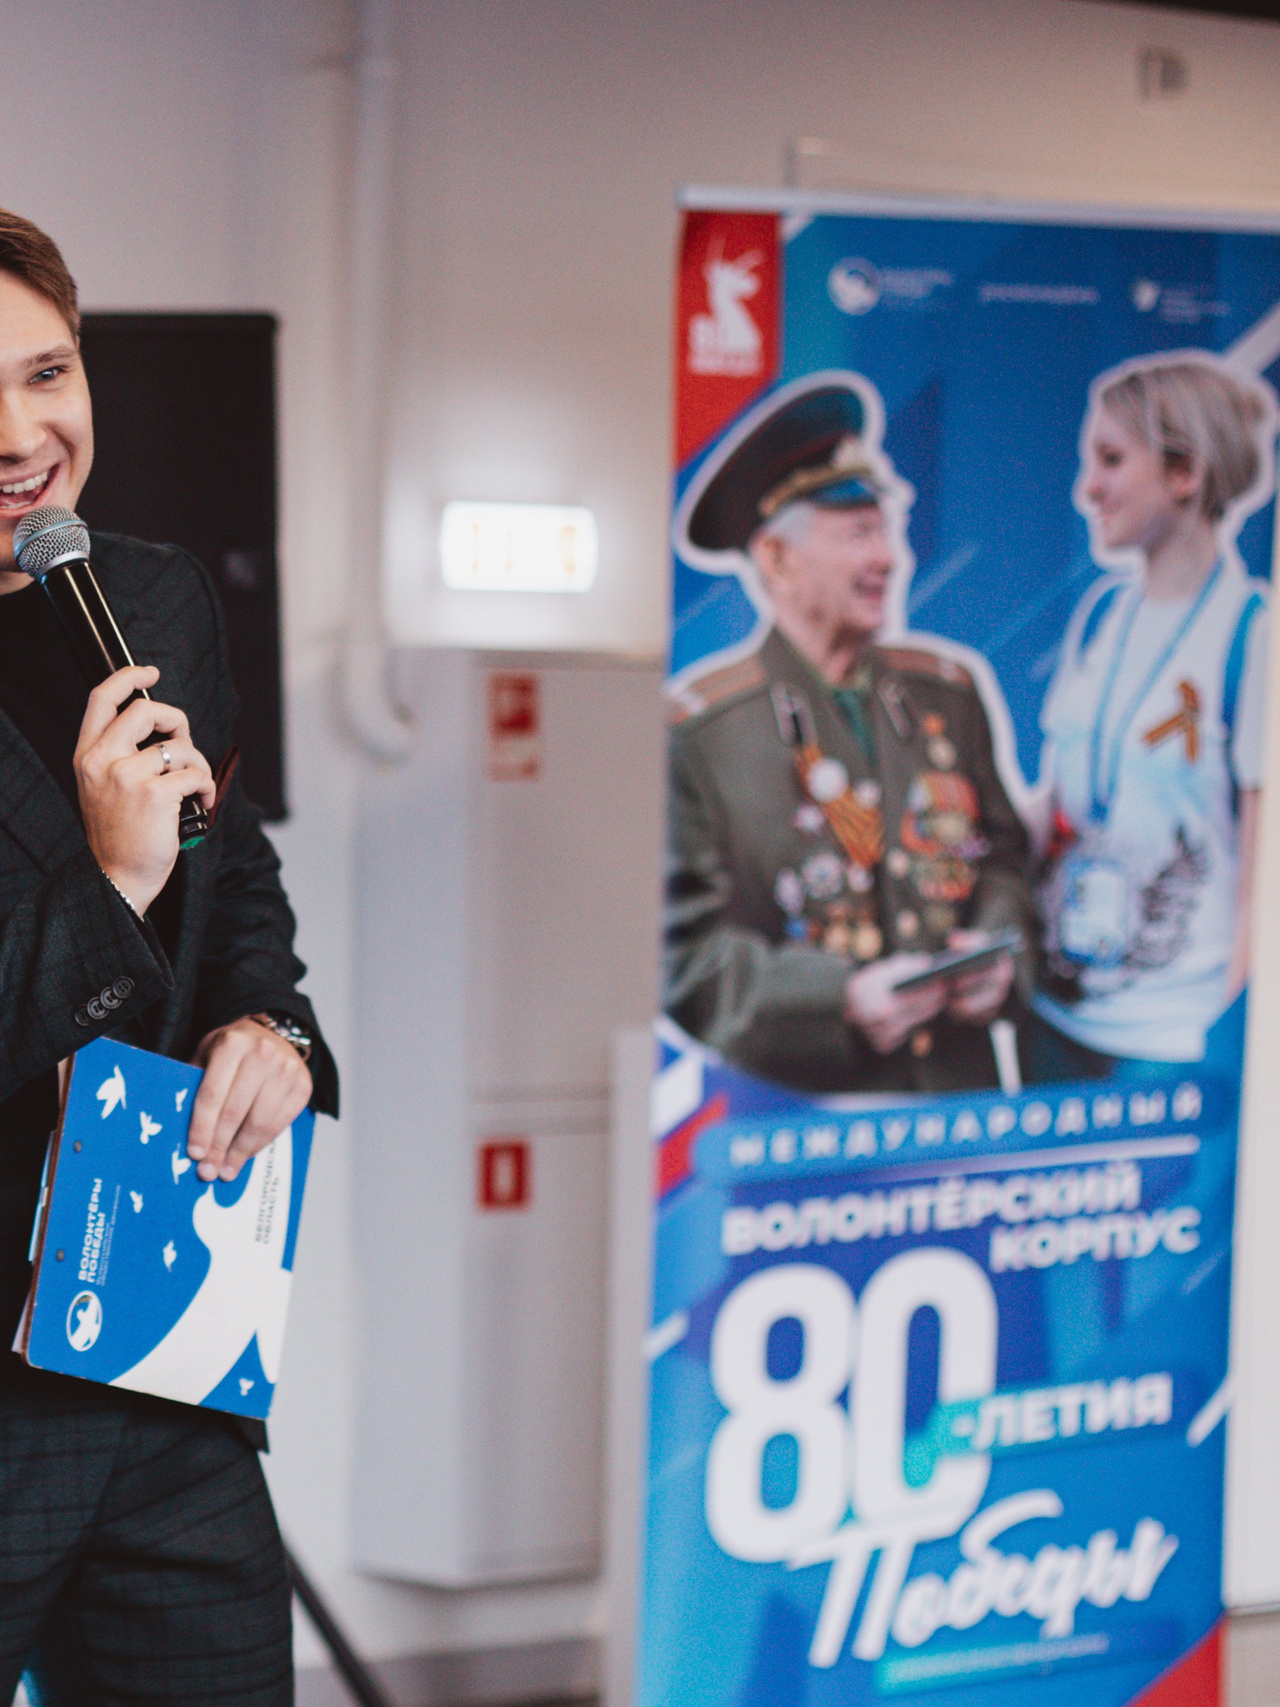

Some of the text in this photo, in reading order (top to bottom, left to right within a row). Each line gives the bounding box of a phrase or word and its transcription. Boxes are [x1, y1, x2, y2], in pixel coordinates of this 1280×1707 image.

[729, 1081, 1203, 1167] МЕЖДУНАРОДНЫЙ
[78, 1178, 102, 1281] ВОЛОНТЁРЫ
[87, 1211, 106, 1283] ПОБЕДЫ
[722, 1161, 1142, 1257] ВОЛОНТЁРСКИЙ
[989, 1206, 1201, 1273] КОРПУС
[787, 1489, 1179, 1669] Победы
